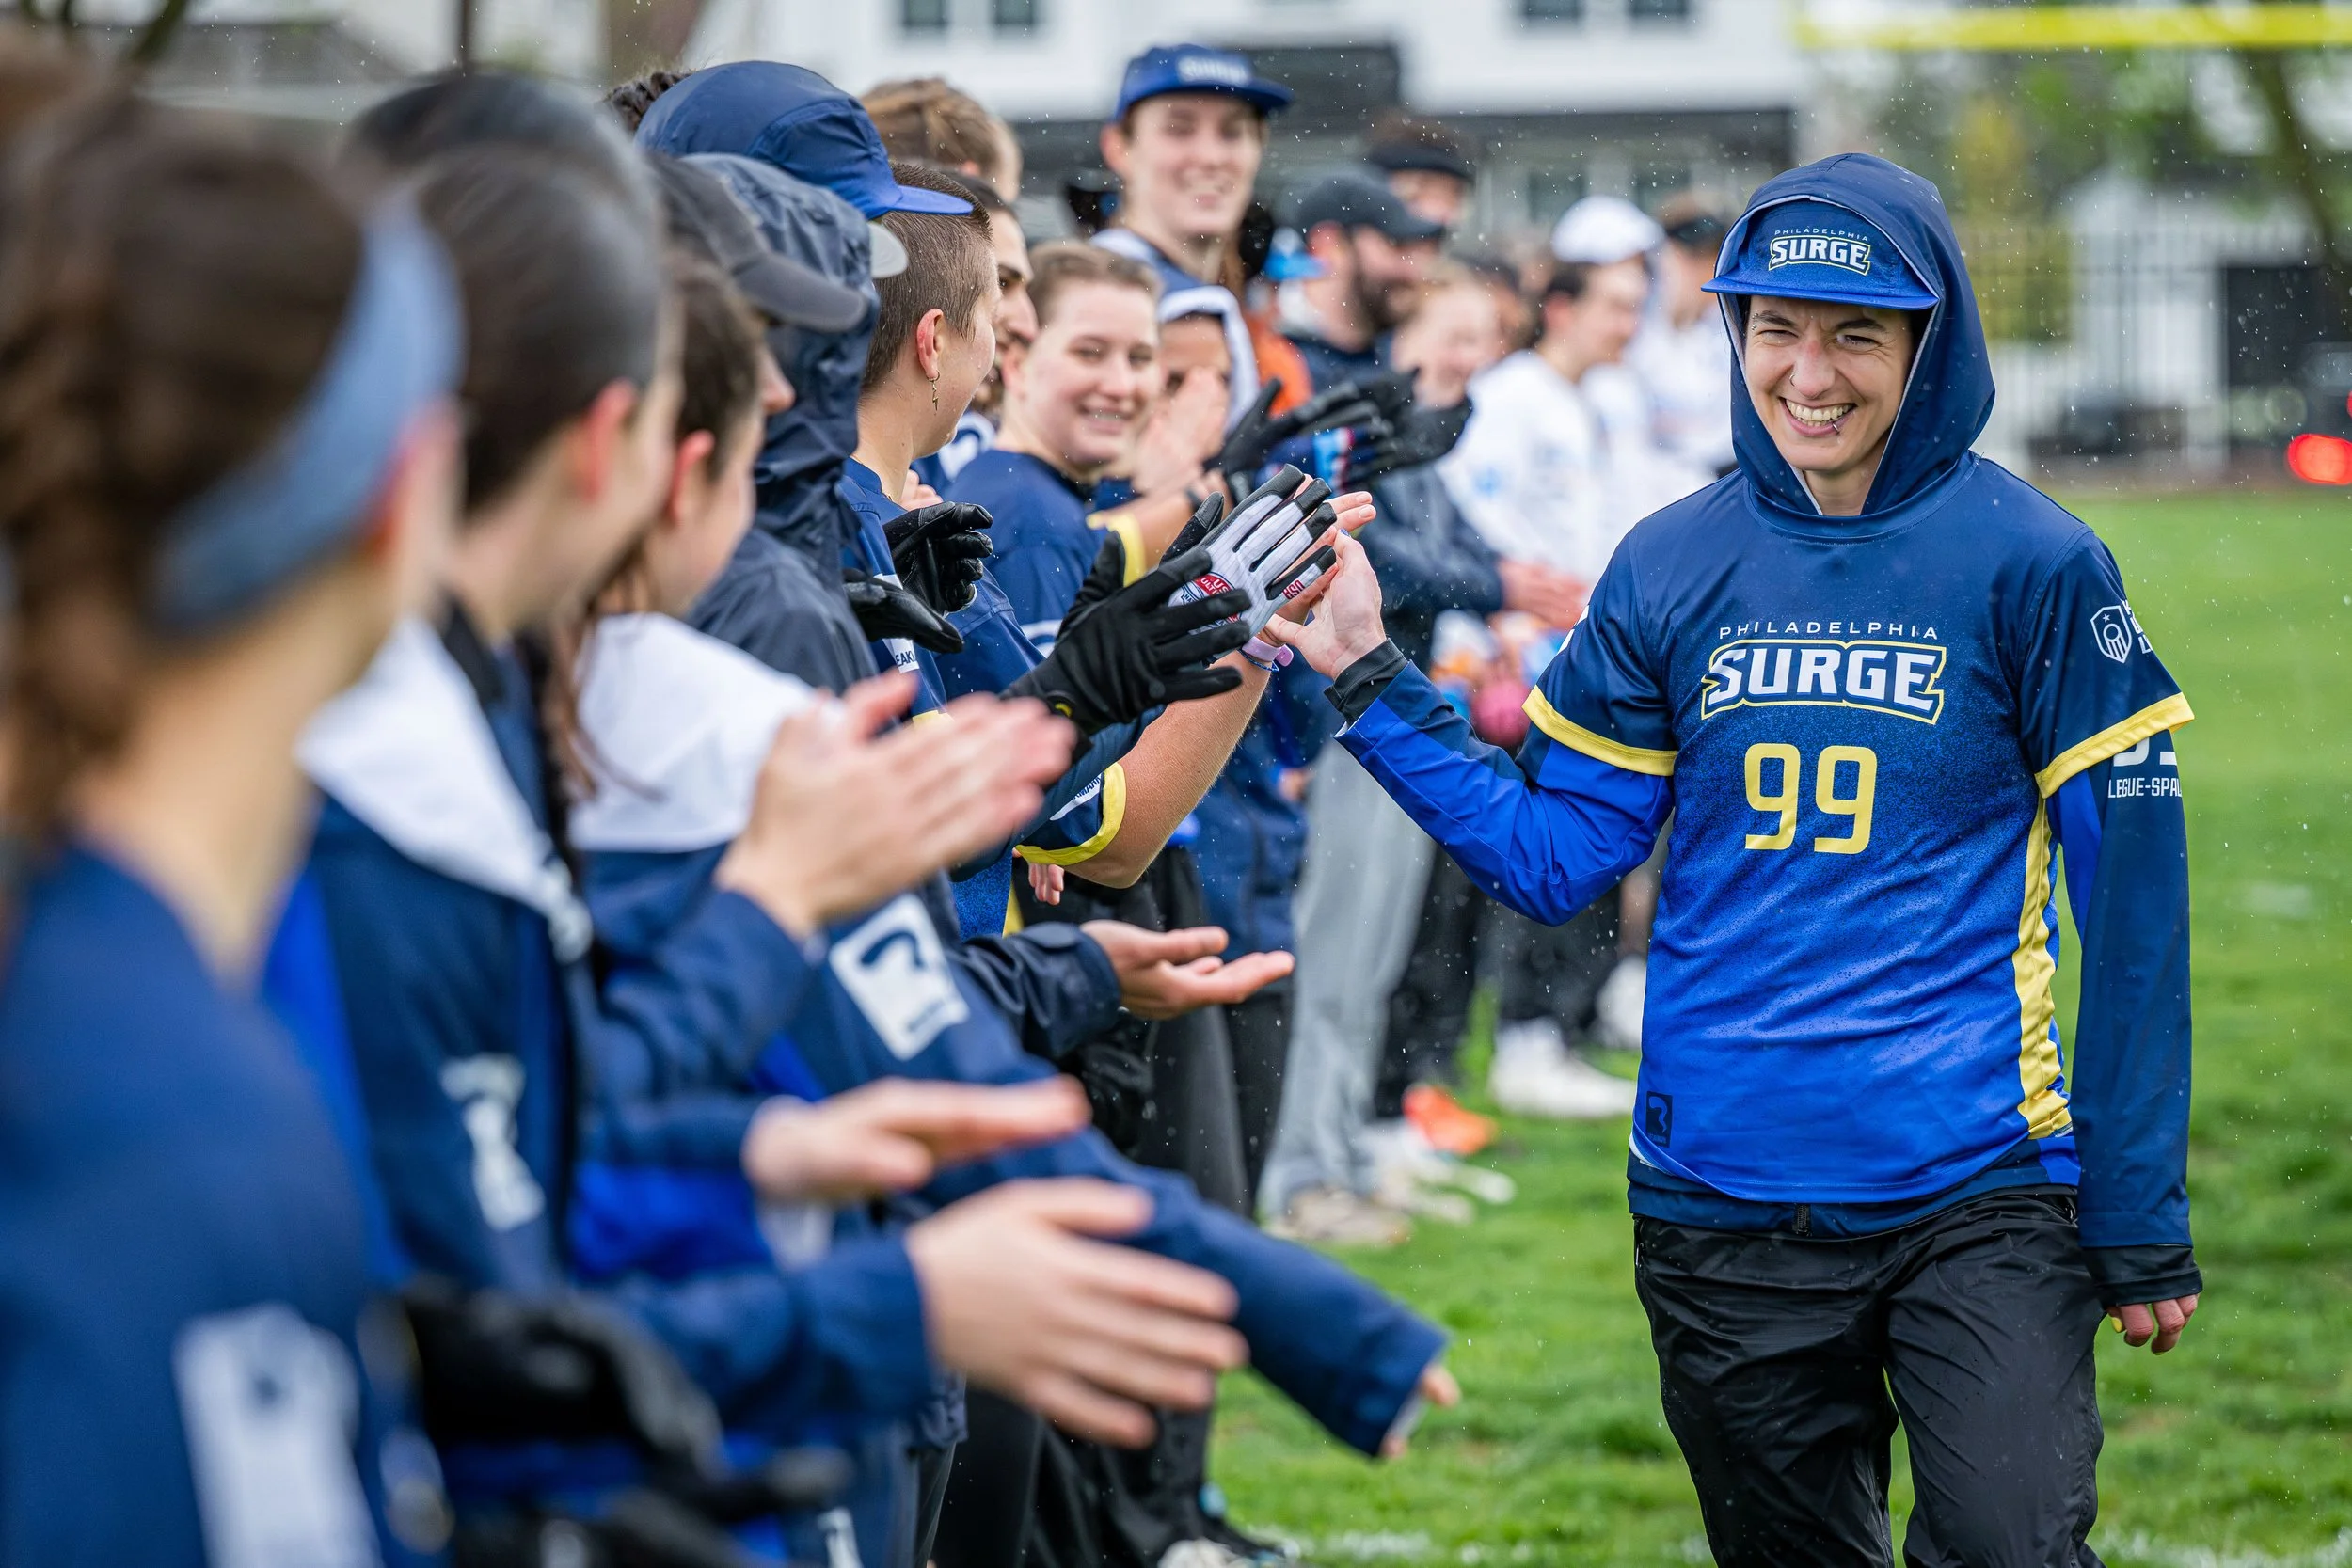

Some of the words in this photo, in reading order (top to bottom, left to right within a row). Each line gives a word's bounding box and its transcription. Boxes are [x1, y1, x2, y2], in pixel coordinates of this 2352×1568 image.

[1774, 228, 1868, 242] PHILADELPHIA
[1770, 237, 1869, 272] SURGE
[1719, 621, 1938, 640] PHILADELPHIA
[1705, 644, 1942, 718] SURGE
[1744, 742, 1878, 855] 99
